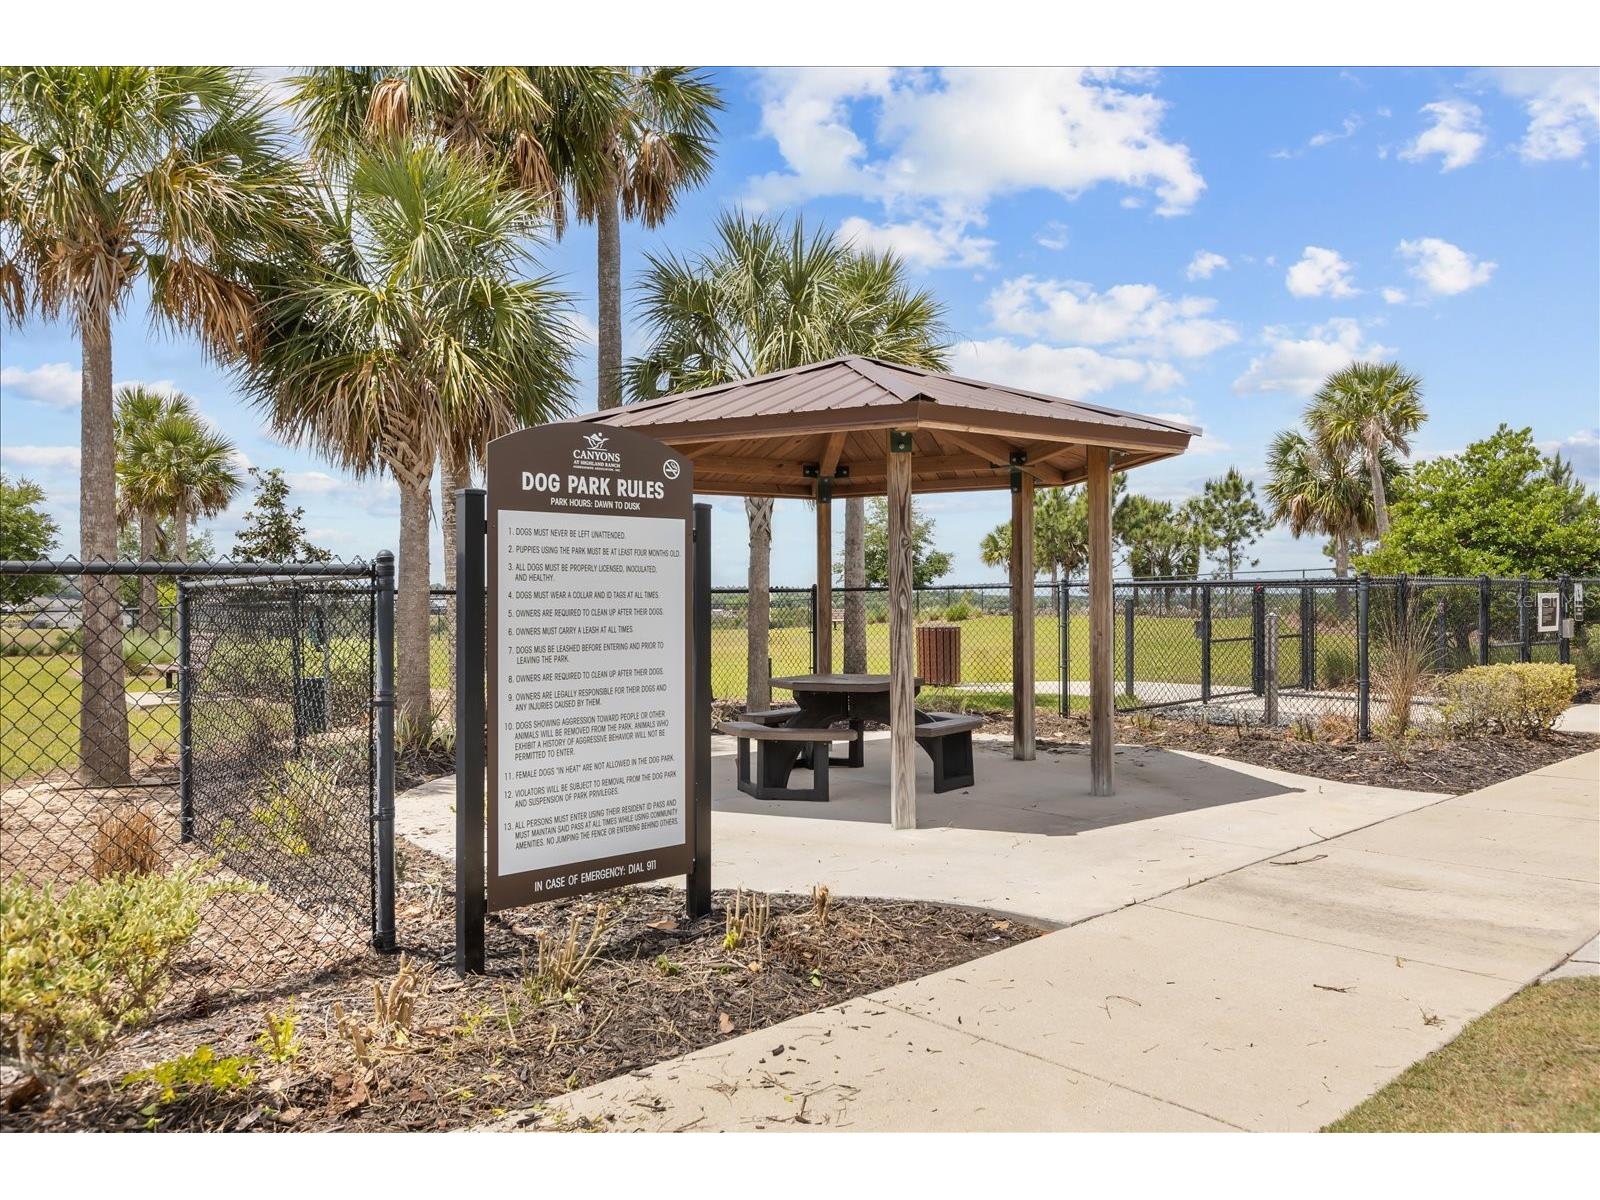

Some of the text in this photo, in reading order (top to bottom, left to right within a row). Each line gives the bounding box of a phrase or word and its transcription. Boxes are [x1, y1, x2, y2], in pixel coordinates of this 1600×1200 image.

[573, 449, 620, 462] CANYONS
[522, 472, 664, 499] DOG PARK RULES
[550, 497, 640, 510] PARK HOURS: DAWN TO DUSK
[534, 528, 548, 536] MUST
[550, 529, 568, 537] NEVER
[578, 530, 589, 538] LEFT
[541, 546, 558, 554] USING
[648, 549, 668, 557] MONTHS
[561, 564, 568, 572] BE
[570, 564, 597, 572] PROPERLY
[542, 627, 557, 635] MUST
[582, 626, 599, 634] LEASH
[516, 646, 532, 654] DOGS
[516, 656, 540, 664] LEAVING
[516, 692, 540, 701] OWNERS
[542, 691, 552, 699] ARE
[554, 690, 576, 698] LEGALLY
[578, 687, 613, 696] RESPONSIBLE
[516, 704, 526, 712] ANY
[528, 702, 553, 710] INJURIES
[554, 700, 575, 709] CAUSED
[516, 721, 532, 730] DOGS
[533, 719, 560, 728] SHOWING
[562, 716, 595, 726] AGGRESSION
[597, 714, 619, 722] TOWARD
[620, 712, 639, 720] PEOPLE
[649, 710, 665, 718] OTHER
[515, 731, 539, 740] ANIMALS
[540, 730, 553, 738] WILL
[564, 726, 590, 736] REMOVED
[591, 725, 606, 733] FROM
[608, 724, 616, 732] THE
[634, 721, 655, 729] ANIMALS
[656, 719, 669, 727] WHO
[515, 741, 535, 750] EXHIBIT
[543, 739, 565, 748] HISTORY
[576, 735, 607, 744] AGGRESSIVE
[608, 732, 633, 741] BEHAVIOR
[635, 731, 646, 739] WILL
[515, 751, 546, 761] PERMITTED
[516, 770, 536, 779] FEMALE
[539, 768, 554, 776] DOGS
[594, 762, 604, 770] NOT
[606, 759, 630, 768] ALLOWED
[638, 757, 647, 765] THE
[515, 787, 545, 798] VIOLATORS
[547, 785, 558, 793] WILL
[561, 784, 567, 792] BE
[570, 781, 592, 790] SUBJECT
[602, 777, 624, 786] REMOVAL
[626, 775, 640, 783] FROM
[652, 772, 663, 780] DOG
[664, 770, 676, 778] PARK
[515, 800, 527, 808] AND
[529, 795, 563, 806] SUSPENSION
[573, 792, 587, 800] PARK
[515, 821, 524, 829] ALL
[526, 817, 552, 827] PERSONS
[554, 814, 568, 823] MUST
[570, 812, 587, 821] ENTER
[588, 809, 604, 818] USING
[606, 807, 620, 816] THEIR
[622, 803, 645, 813] RESIDENT
[653, 800, 665, 808] PASS
[534, 860, 656, 892] IN CASE OF EMERGENCY: DIAL 911
